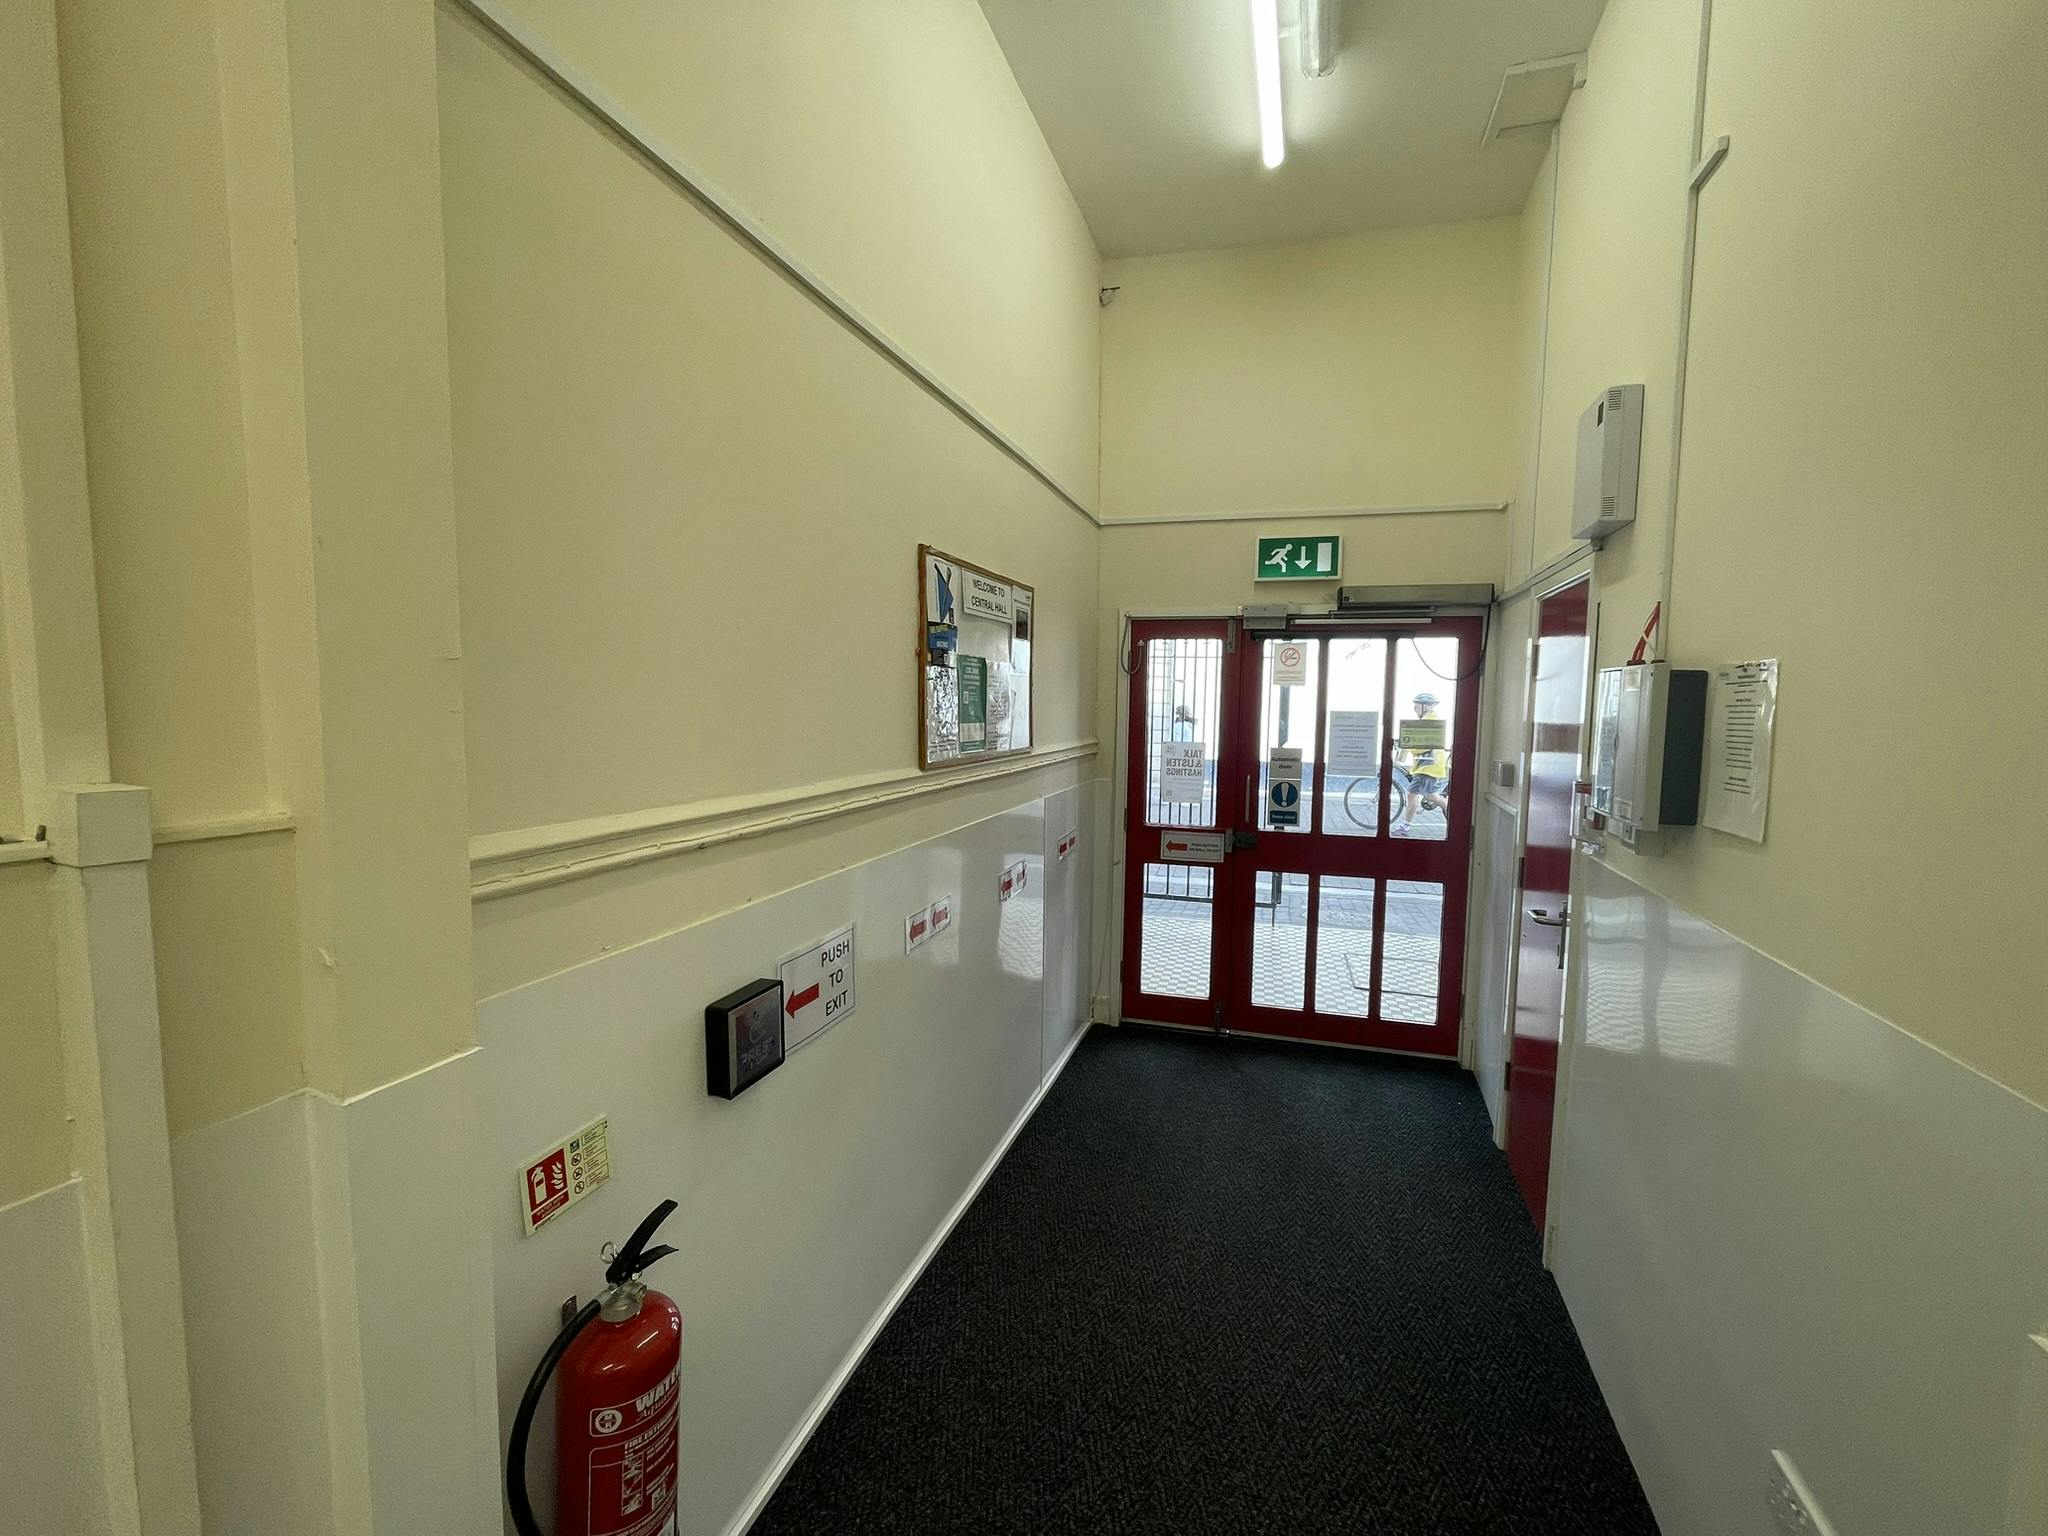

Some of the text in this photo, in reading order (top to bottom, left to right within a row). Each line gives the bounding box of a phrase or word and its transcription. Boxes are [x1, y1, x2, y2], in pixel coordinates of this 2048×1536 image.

[972, 578, 1005, 598] WELCOME TO
[971, 595, 1007, 614] CENTRAL HALL
[821, 939, 850, 968] PUSH
[829, 969, 843, 988] TO
[825, 989, 849, 1017] EXIT
